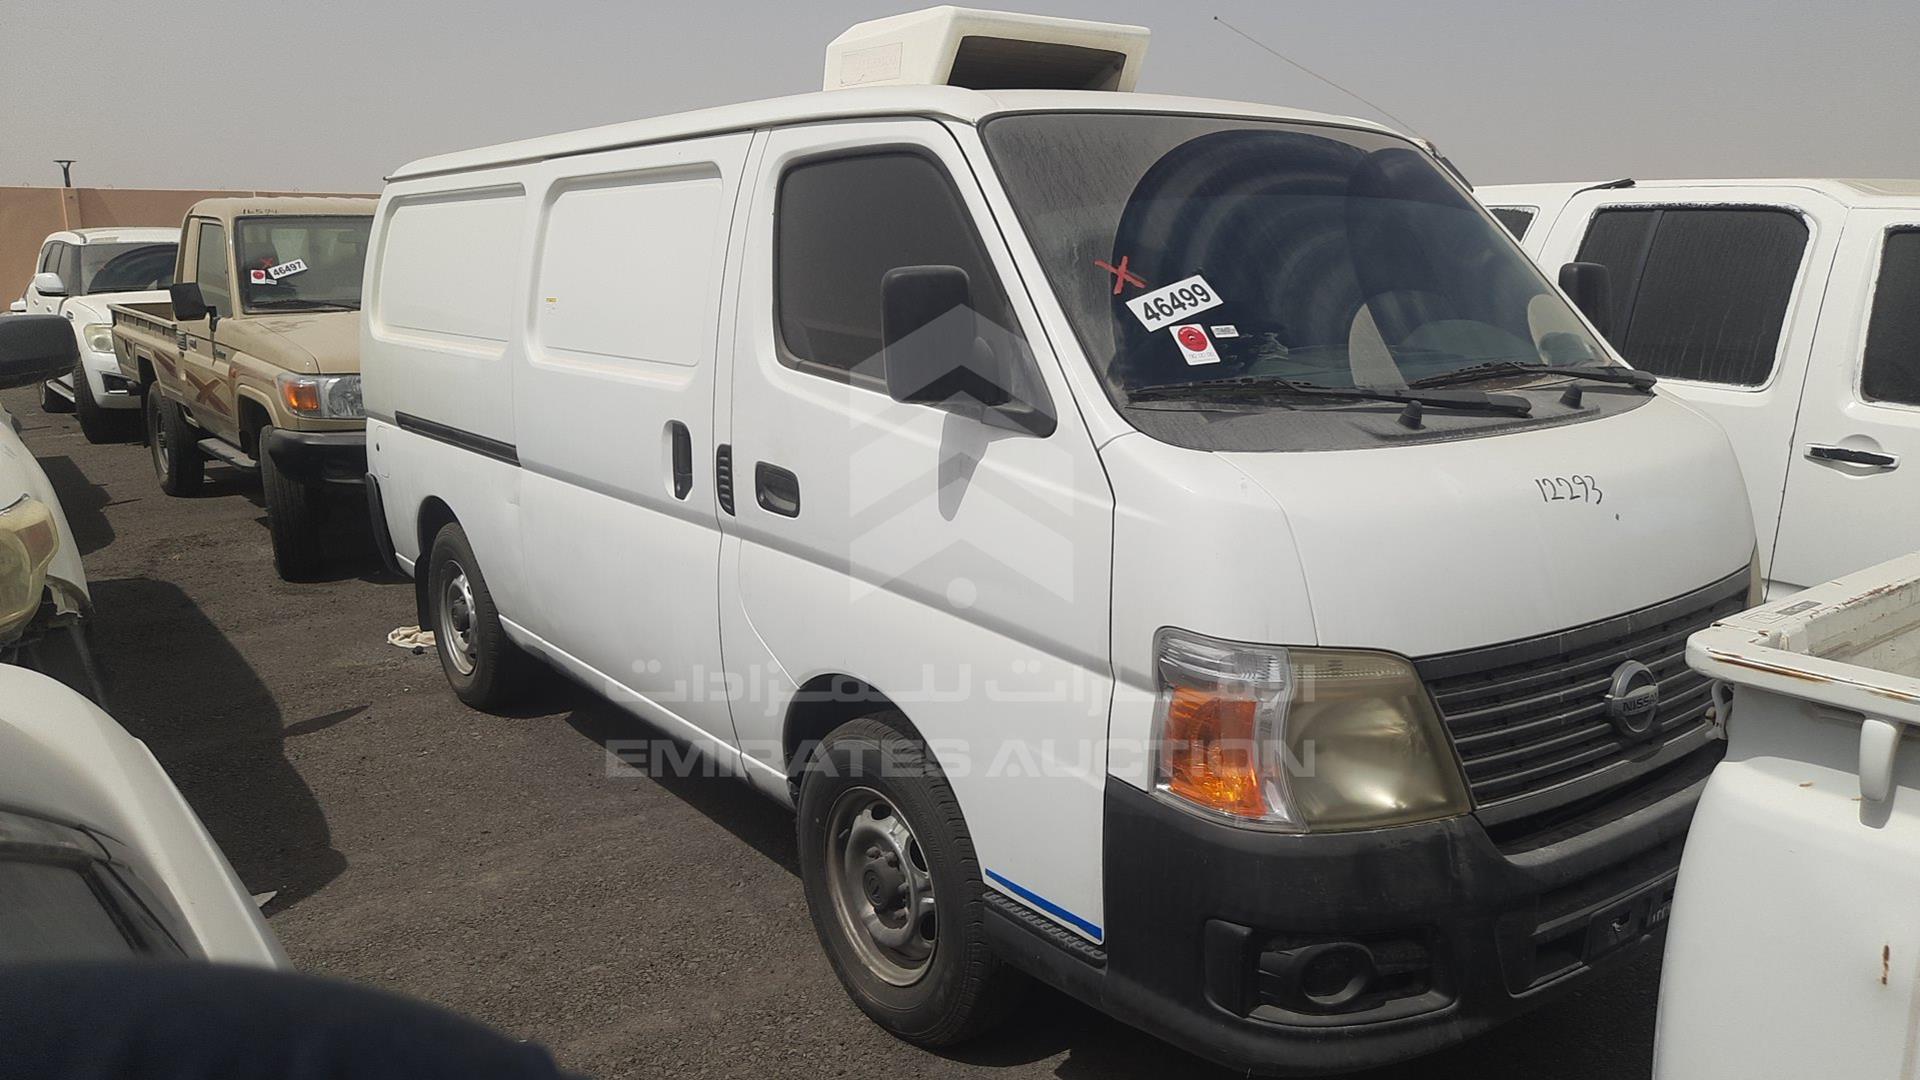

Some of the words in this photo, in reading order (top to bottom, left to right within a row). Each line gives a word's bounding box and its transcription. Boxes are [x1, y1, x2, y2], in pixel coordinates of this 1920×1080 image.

[272, 261, 302, 276] 46497
[1142, 283, 1212, 322] 46499
[1534, 474, 1603, 505] 12293
[1622, 691, 1659, 712] NISSAN
